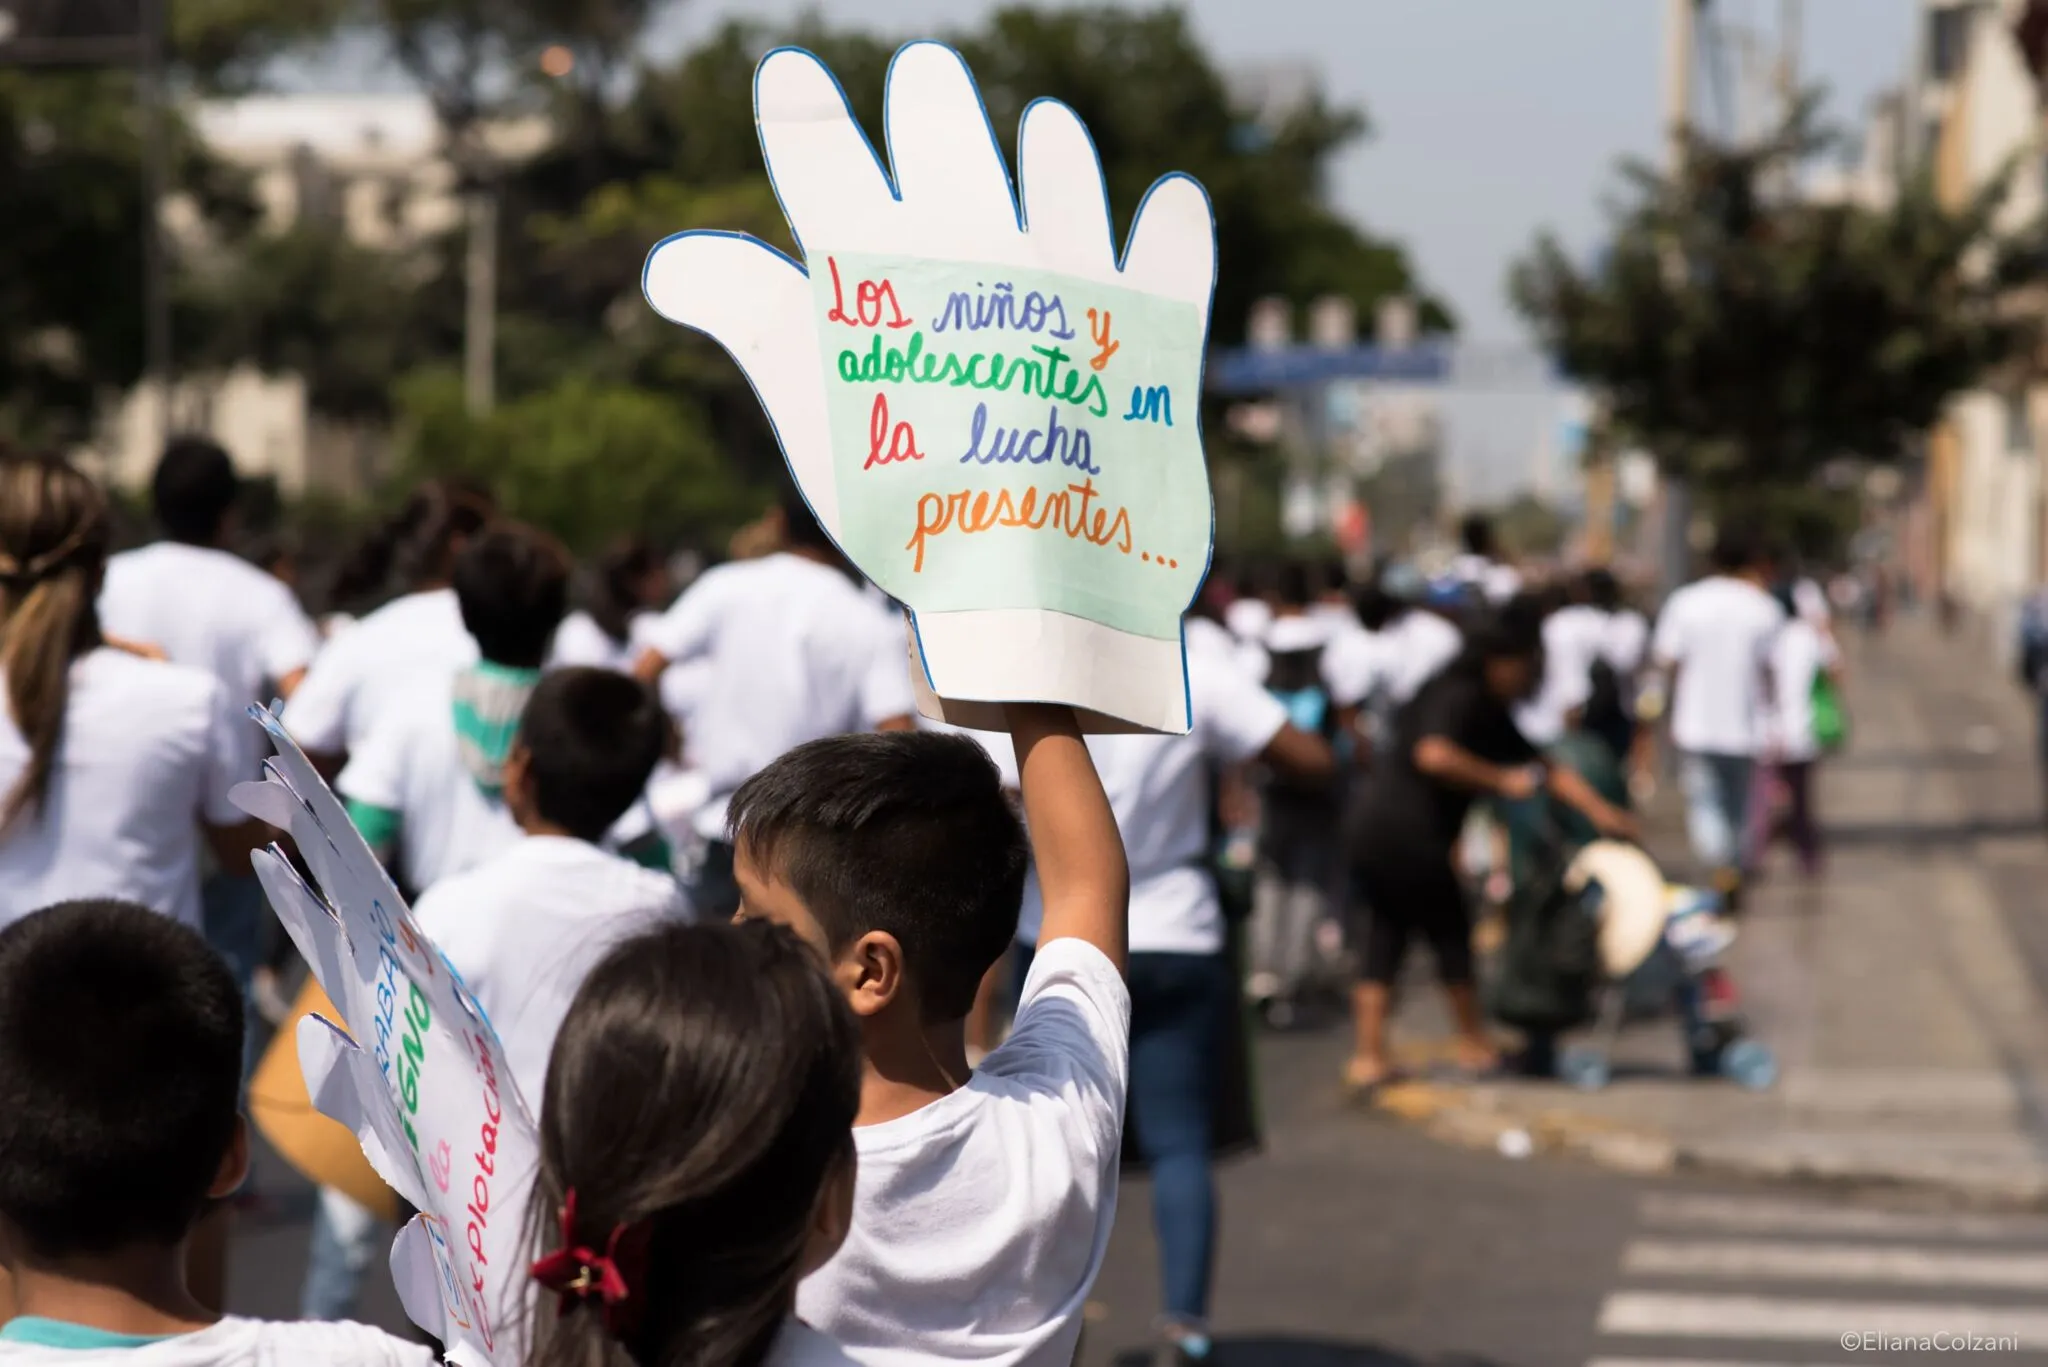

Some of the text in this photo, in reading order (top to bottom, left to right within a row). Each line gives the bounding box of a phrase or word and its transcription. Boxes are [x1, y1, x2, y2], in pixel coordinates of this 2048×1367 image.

[828, 256, 1119, 371] Los niños y
[838, 331, 1174, 427] adolescentes en
[863, 392, 1100, 475] la lucha
[906, 478, 1178, 573] presentes...
